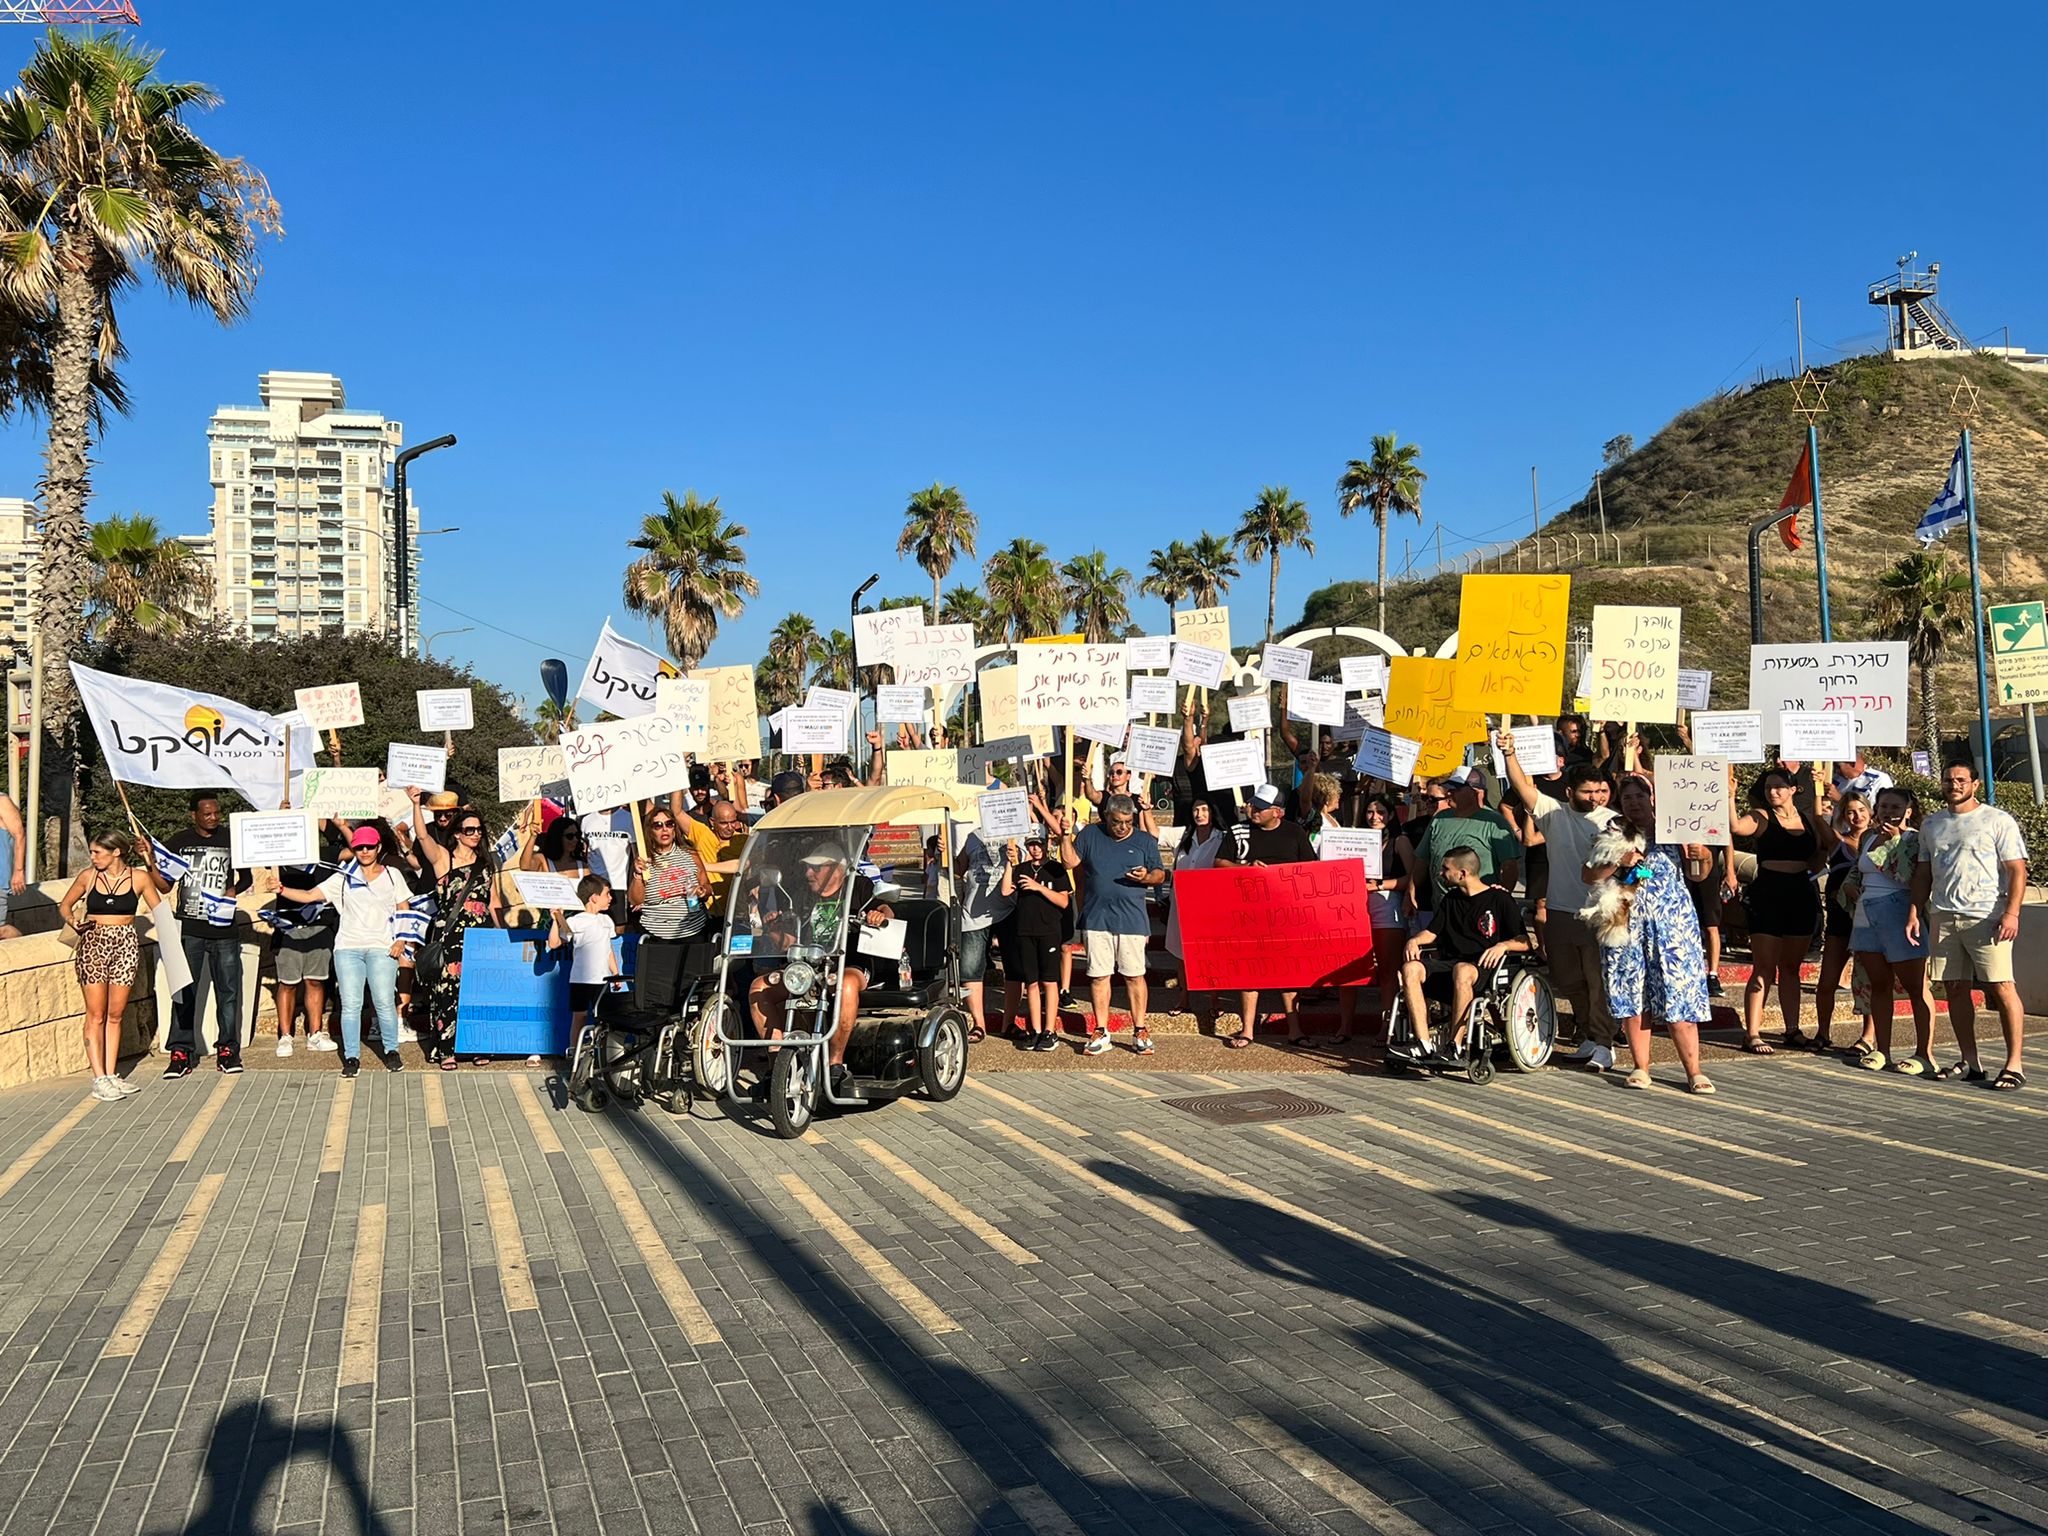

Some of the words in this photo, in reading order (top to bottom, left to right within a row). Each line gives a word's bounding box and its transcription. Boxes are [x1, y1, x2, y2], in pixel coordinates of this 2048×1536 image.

[1762, 656, 1819, 671] מסעדות
[1827, 653, 1889, 668] סגירת
[1819, 675, 1858, 692] החוף
[1597, 687, 1665, 702] משפחות
[2025, 689, 2040, 698] 800
[1779, 699, 1805, 712] את
[1822, 696, 1892, 712] תהרוג
[214, 750, 262, 758] מסעדה
[1701, 760, 1721, 772] גם
